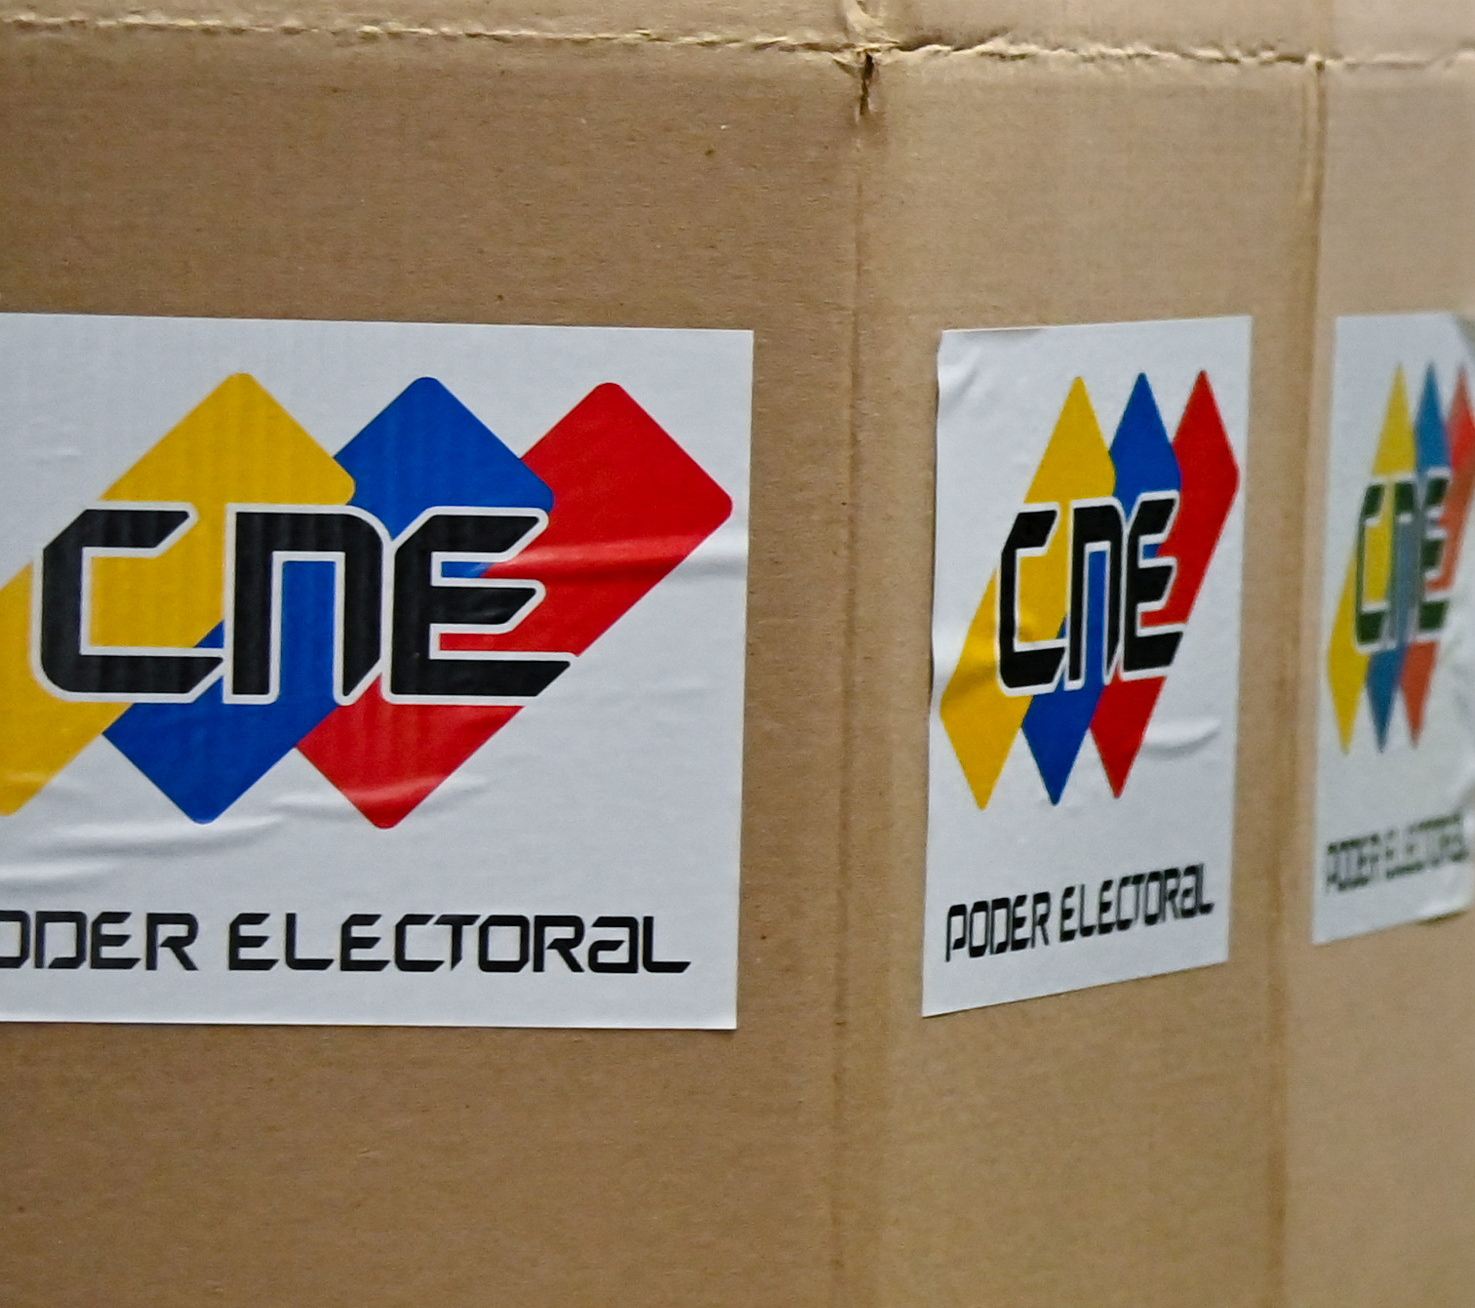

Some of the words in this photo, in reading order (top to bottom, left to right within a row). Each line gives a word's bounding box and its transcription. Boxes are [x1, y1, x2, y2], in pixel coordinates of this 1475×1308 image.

[38, 507, 573, 699] CNE
[999, 495, 1182, 689] CNE
[0, 909, 199, 971] ODER
[945, 891, 1051, 963] PODER
